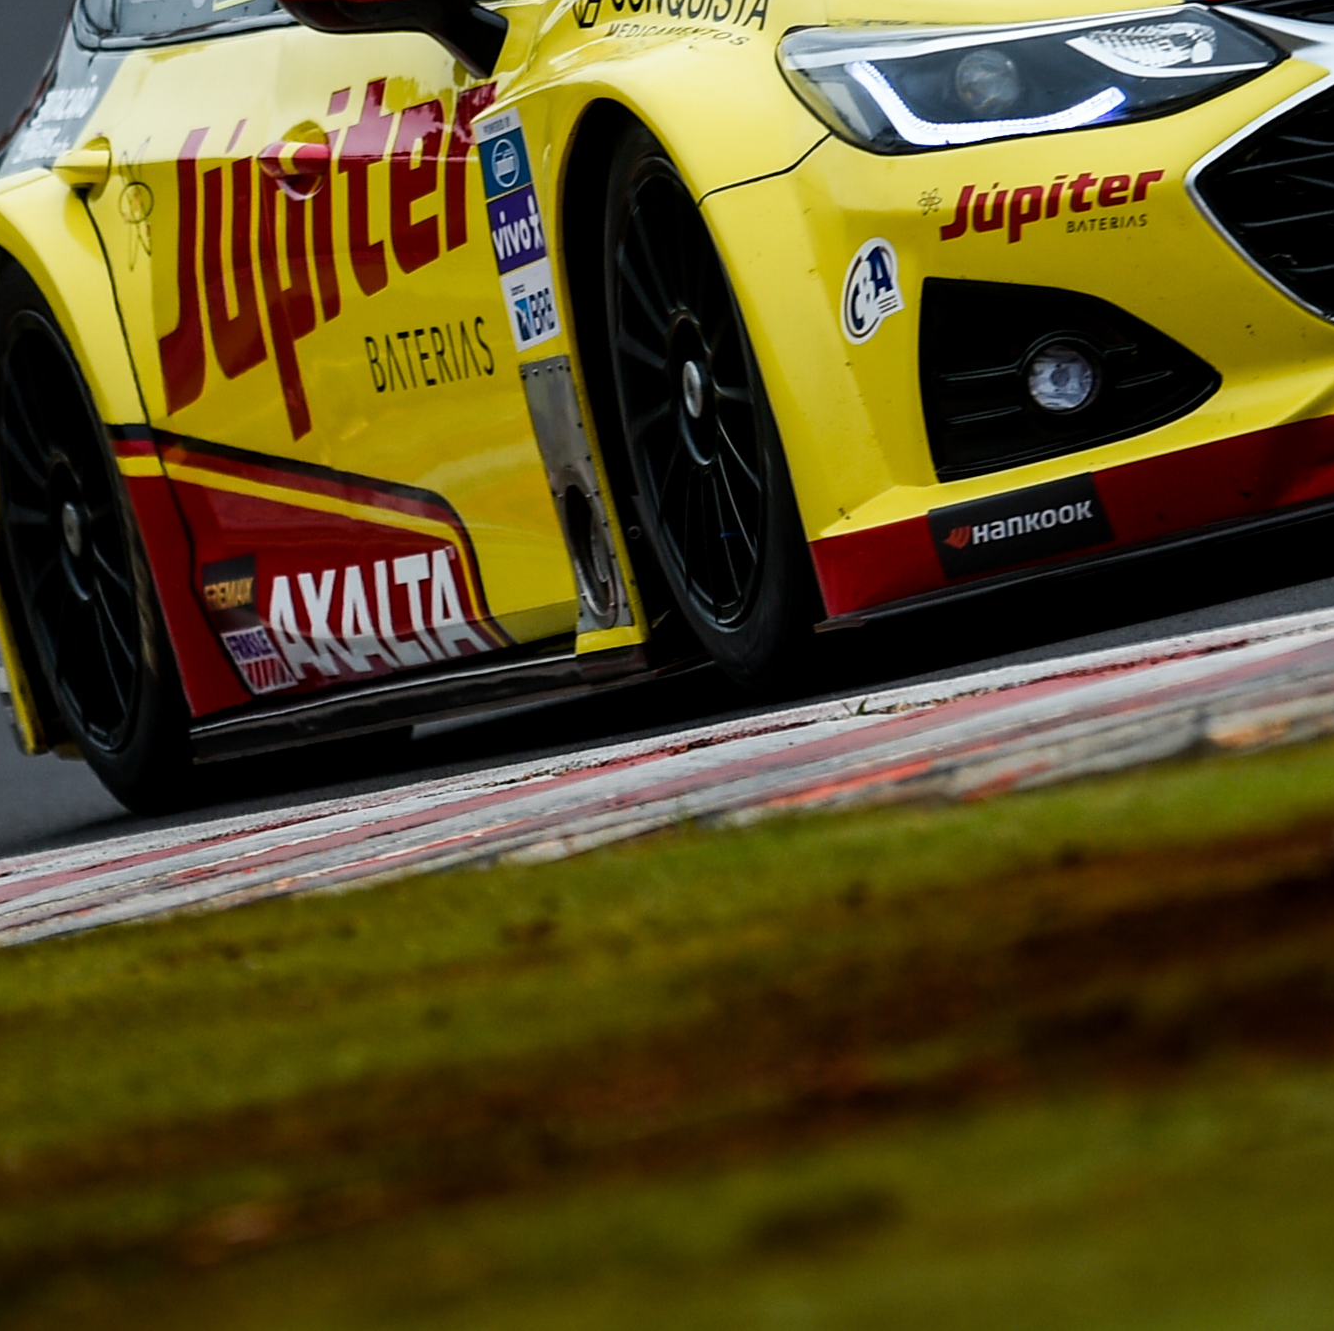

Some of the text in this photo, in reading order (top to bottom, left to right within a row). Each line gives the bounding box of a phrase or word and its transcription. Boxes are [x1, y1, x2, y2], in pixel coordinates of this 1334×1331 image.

[605, 23, 751, 47] MEDICAMENTOS
[940, 169, 1165, 244] Júpiter
[1066, 214, 1148, 234] BATERIAS
[160, 77, 498, 443] Júpiter
[364, 316, 495, 394] BATERIAS
[269, 547, 494, 681] AXALTA
